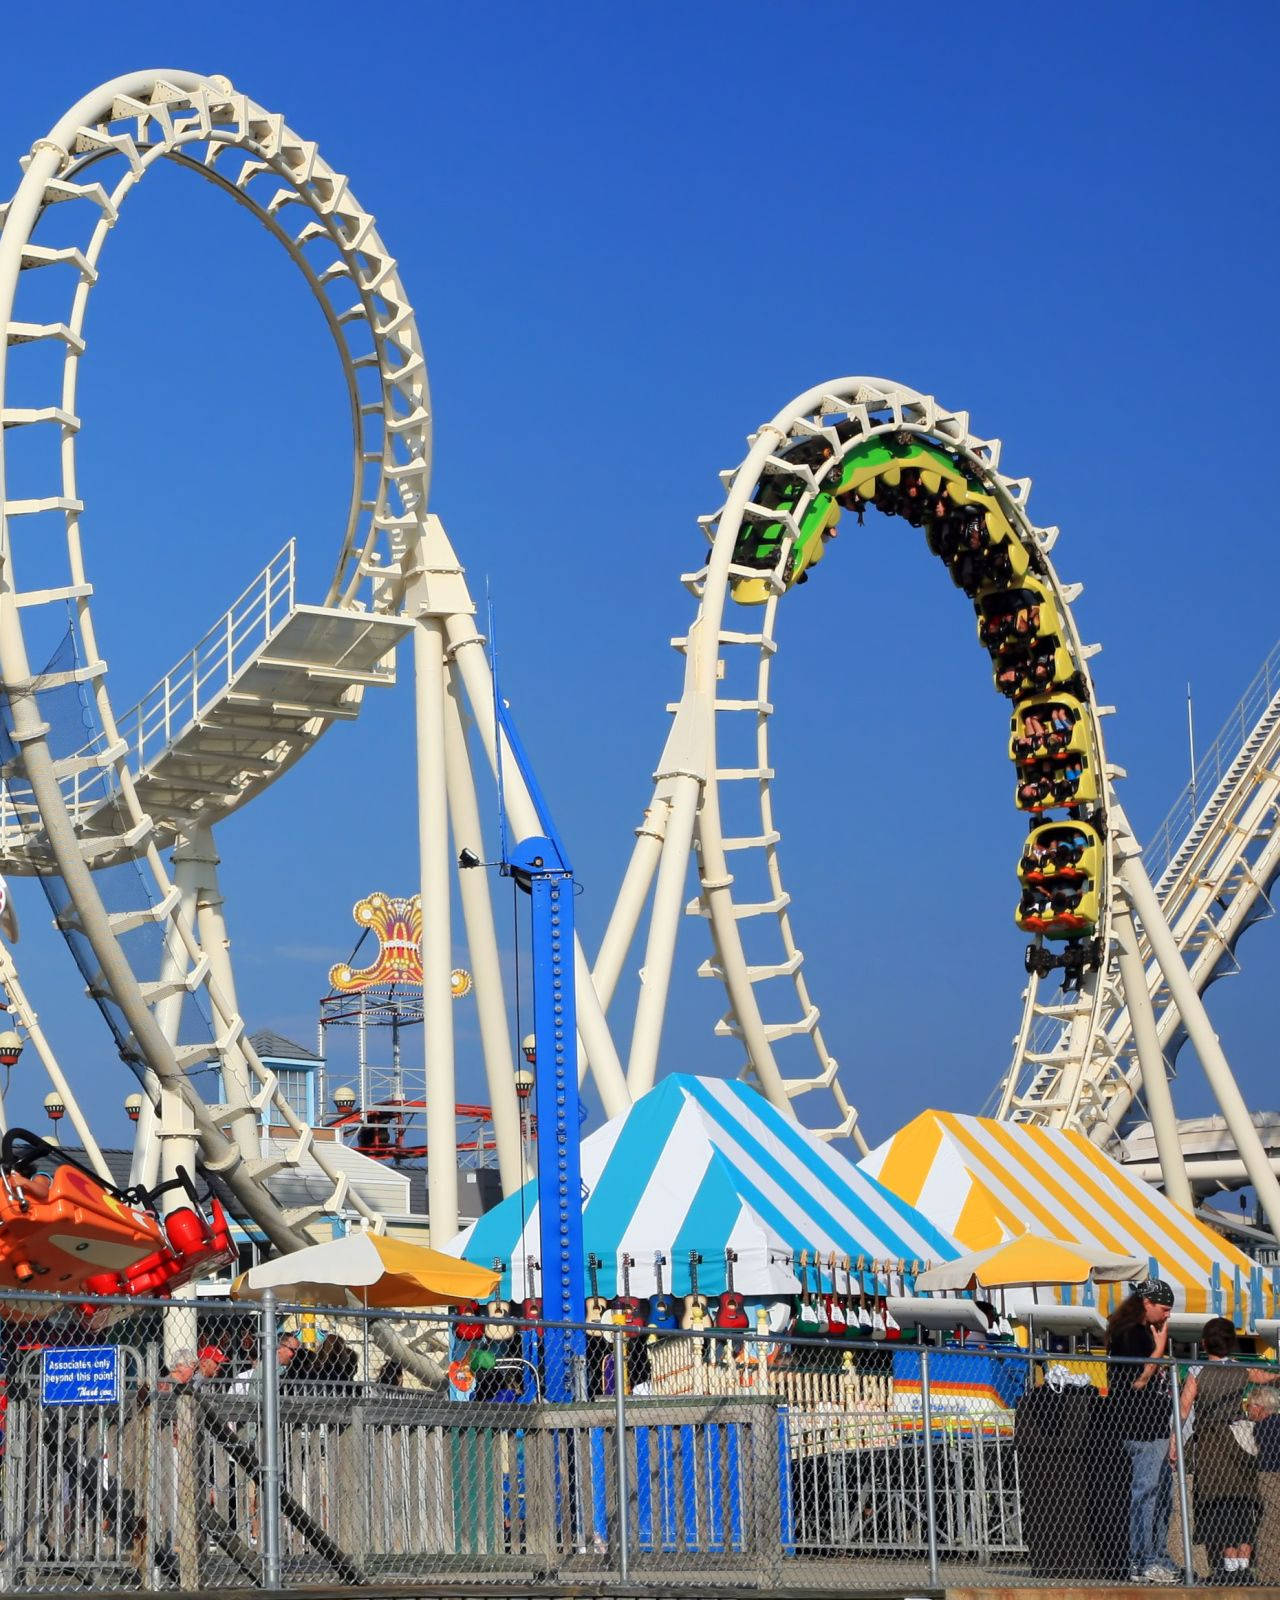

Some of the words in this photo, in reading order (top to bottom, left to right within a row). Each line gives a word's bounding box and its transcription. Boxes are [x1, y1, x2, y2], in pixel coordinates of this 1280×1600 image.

[49, 1359, 92, 1370] Associates
[94, 1359, 111, 1370] only
[45, 1373, 74, 1384] beyond
[76, 1372, 91, 1382] this
[93, 1371, 114, 1382] point
[77, 1386, 99, 1397] Thank
